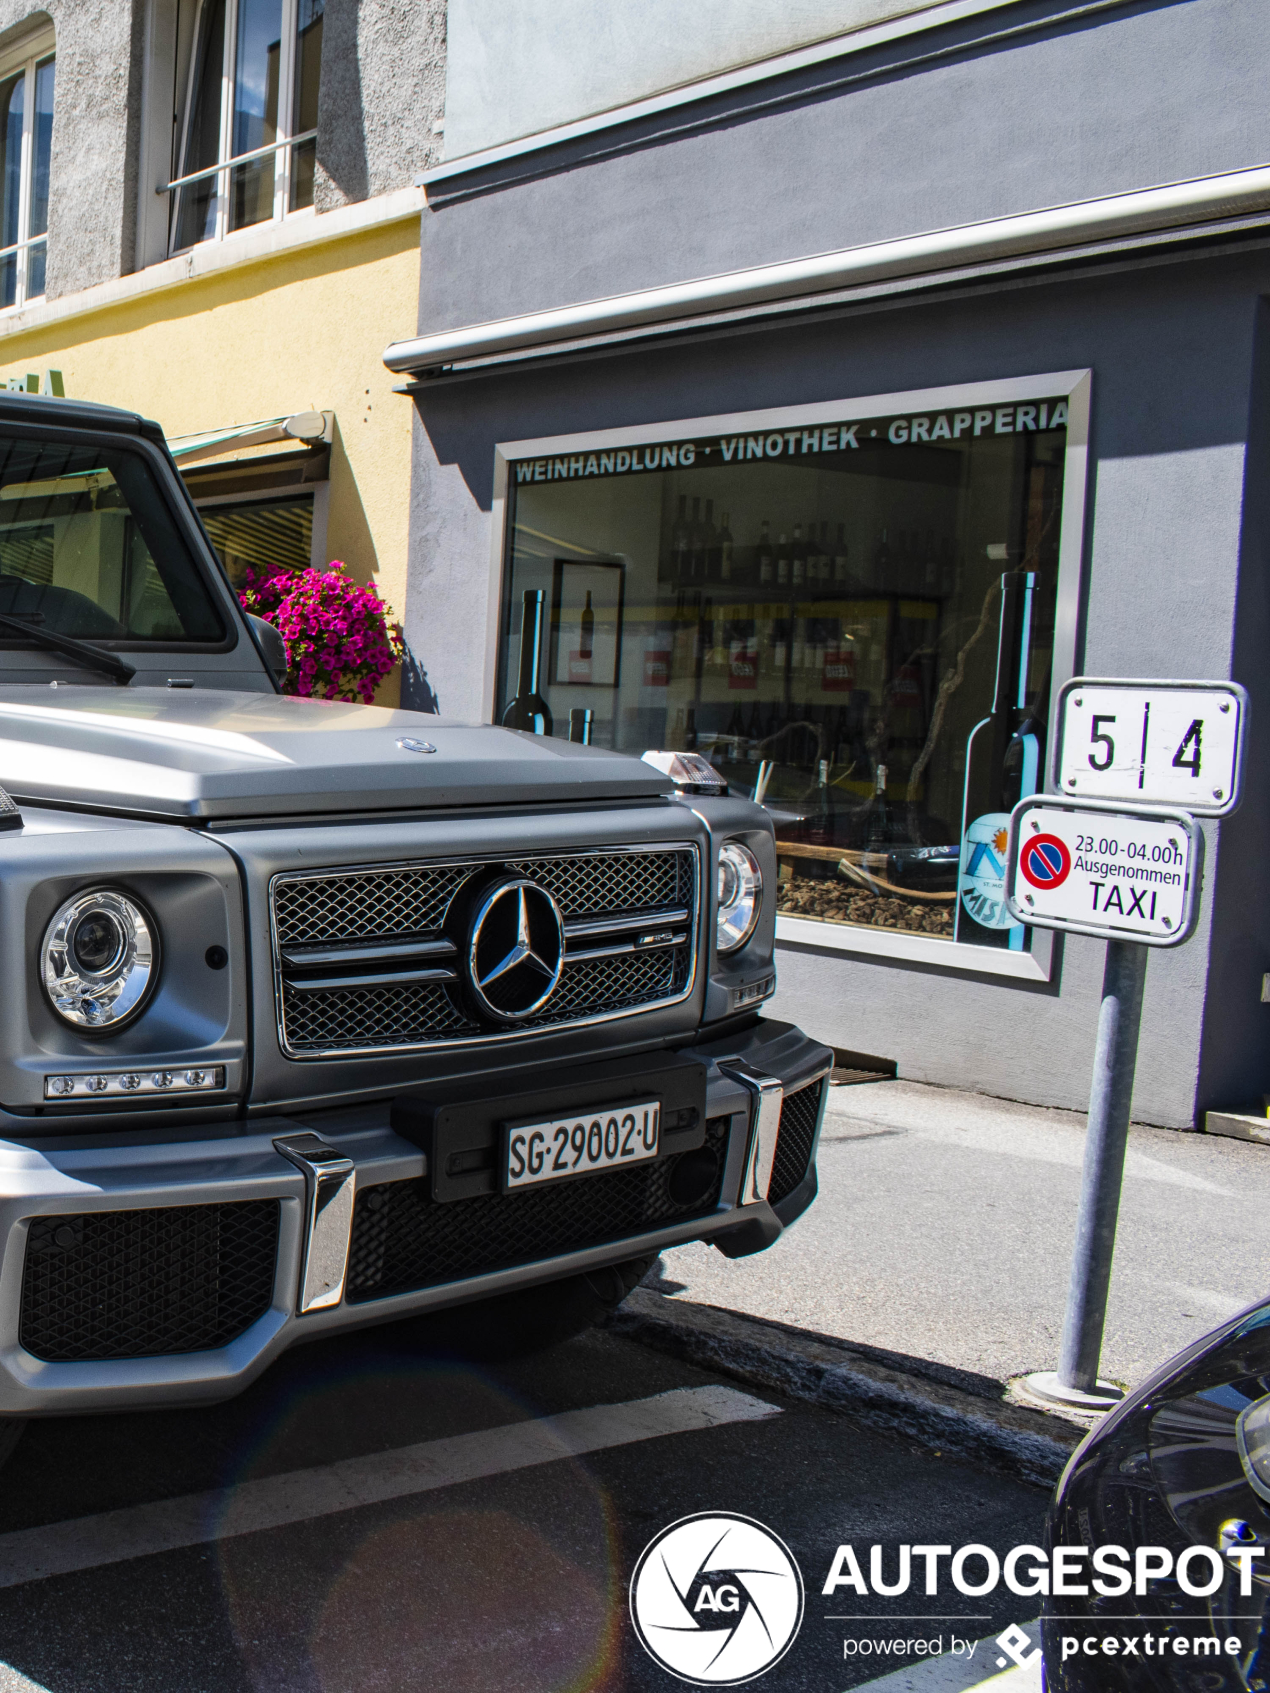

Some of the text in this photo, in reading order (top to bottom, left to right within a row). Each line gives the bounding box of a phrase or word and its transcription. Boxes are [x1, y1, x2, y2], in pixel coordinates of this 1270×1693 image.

[516, 401, 1068, 483] WEINHANDLUNG VINOTHEK GRAPPERIA
[1087, 714, 1205, 778] 5 4
[1073, 855, 1182, 886] Ausgenommen
[1088, 881, 1158, 921] TAXI
